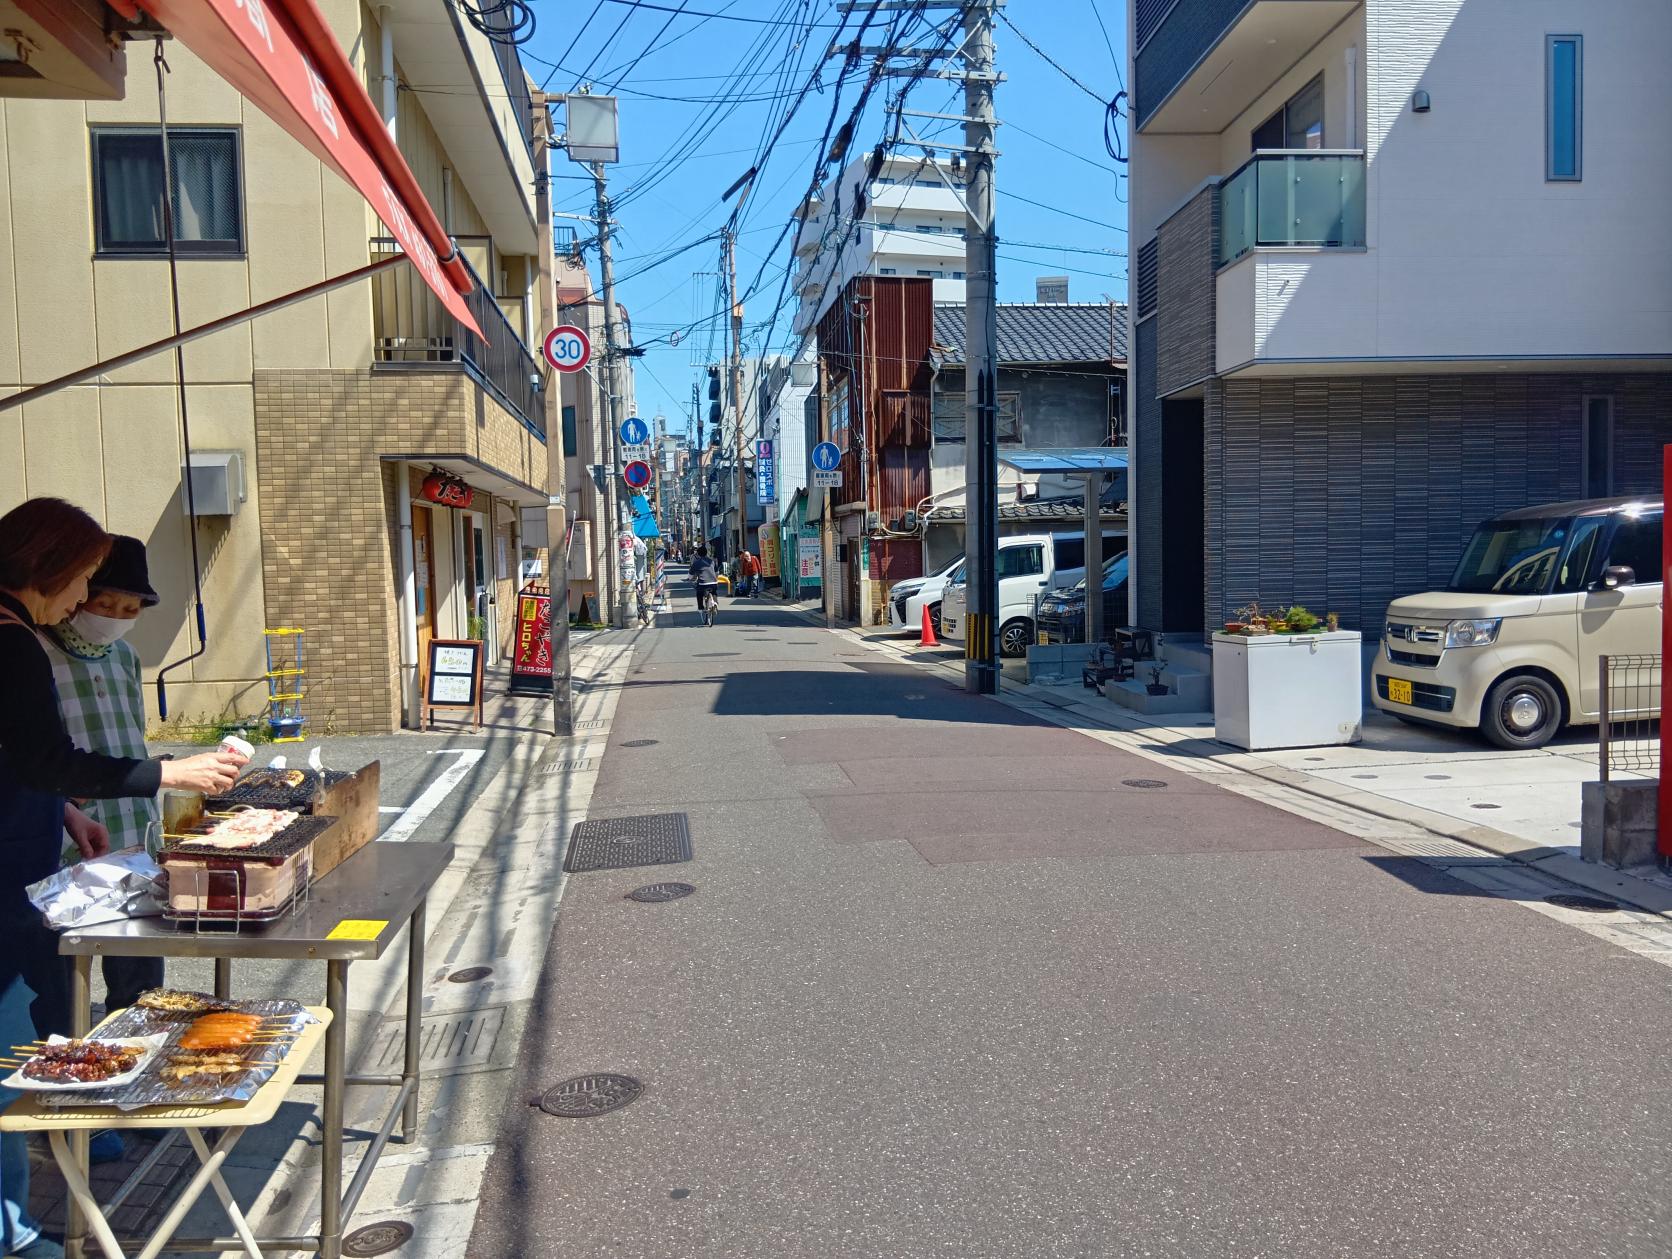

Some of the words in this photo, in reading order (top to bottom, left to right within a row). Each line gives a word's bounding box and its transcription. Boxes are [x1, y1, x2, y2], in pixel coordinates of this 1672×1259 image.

[555, 339, 581, 360] 30
[520, 622, 533, 663] ヒロちゃん
